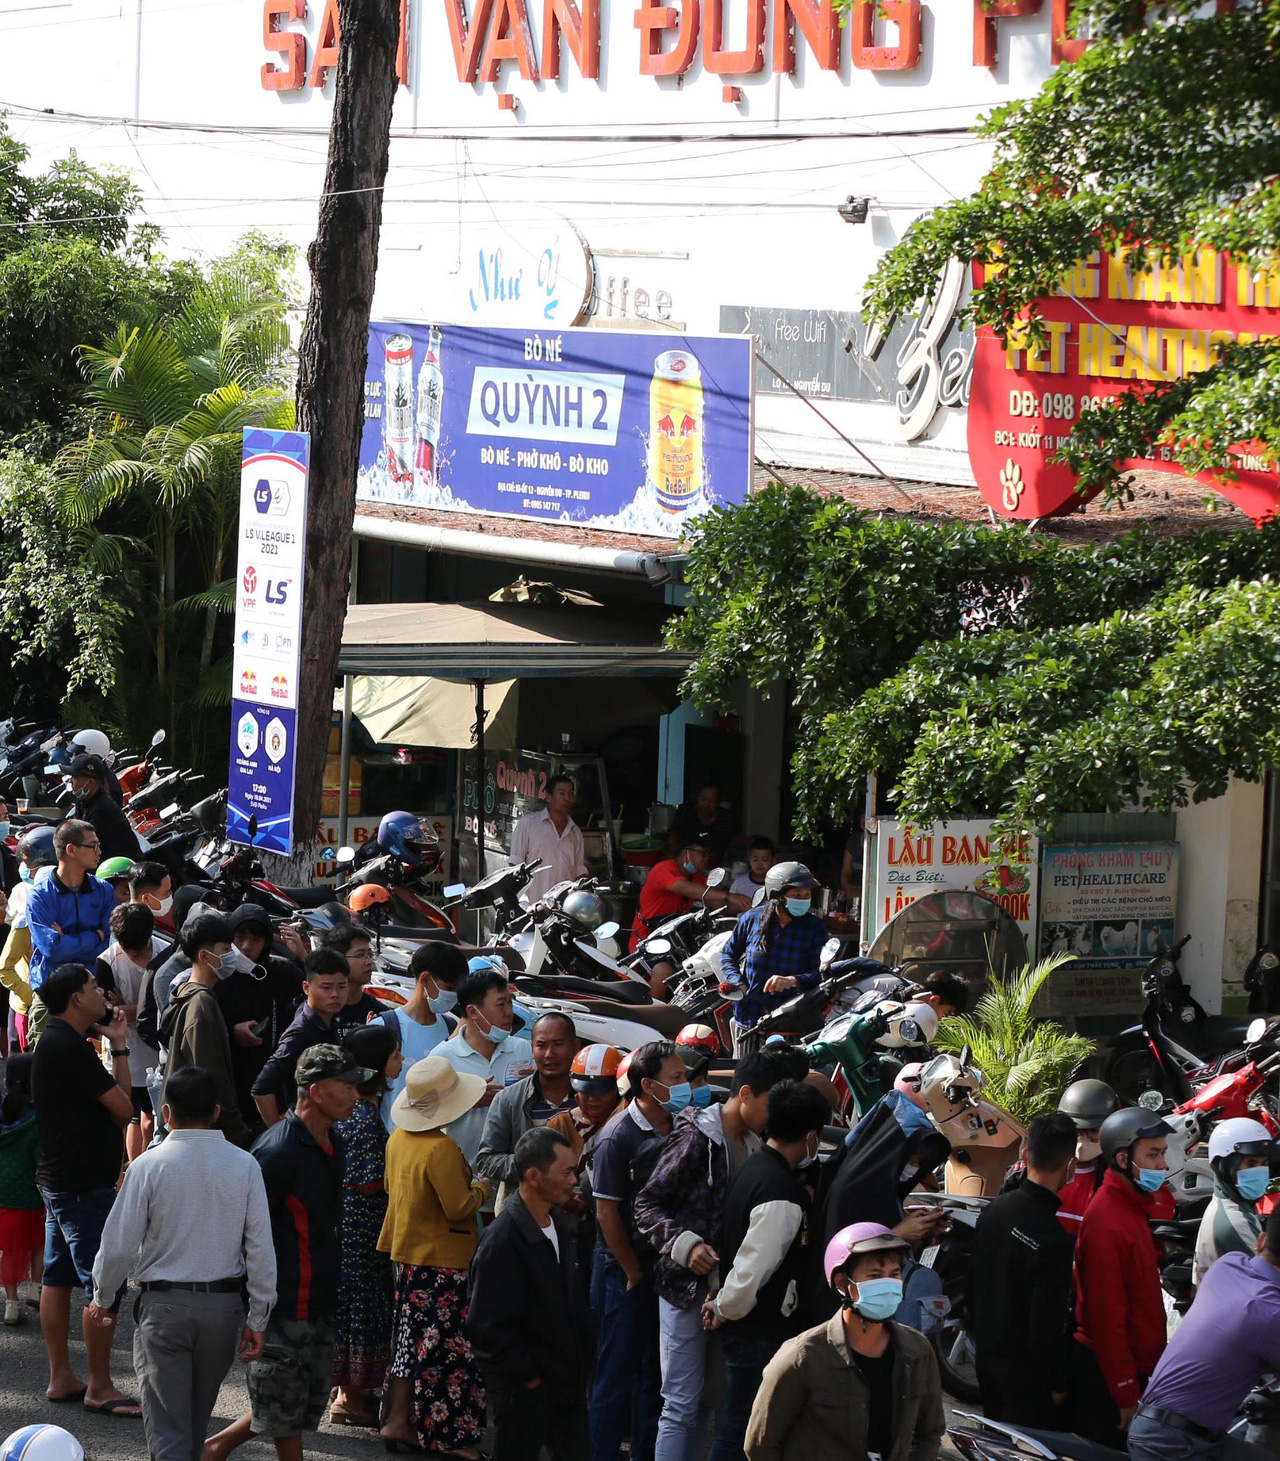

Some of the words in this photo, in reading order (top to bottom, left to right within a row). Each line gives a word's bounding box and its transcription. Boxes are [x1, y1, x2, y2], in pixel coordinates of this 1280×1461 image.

[524, 337, 543, 363] BÒ
[546, 335, 563, 363] NÉ
[480, 373, 583, 431] QUỲNH
[592, 388, 608, 431] 2
[1042, 392, 1075, 420] 098
[480, 446, 496, 466] BÒ
[496, 447, 510, 466] NÉ
[516, 445, 537, 470] PHỞ
[539, 448, 561, 472] KHÔ
[569, 451, 585, 474] BÒ
[586, 457, 609, 476] KHO
[245, 528, 254, 539] LS
[260, 543, 279, 555] 2021
[242, 598, 257, 609] VPF
[265, 579, 288, 605] LS
[538, 771, 548, 800] 2
[941, 834, 990, 867] BAN
[1053, 875, 1078, 887] PET
[1082, 872, 1166, 886] HEALTHCARE
